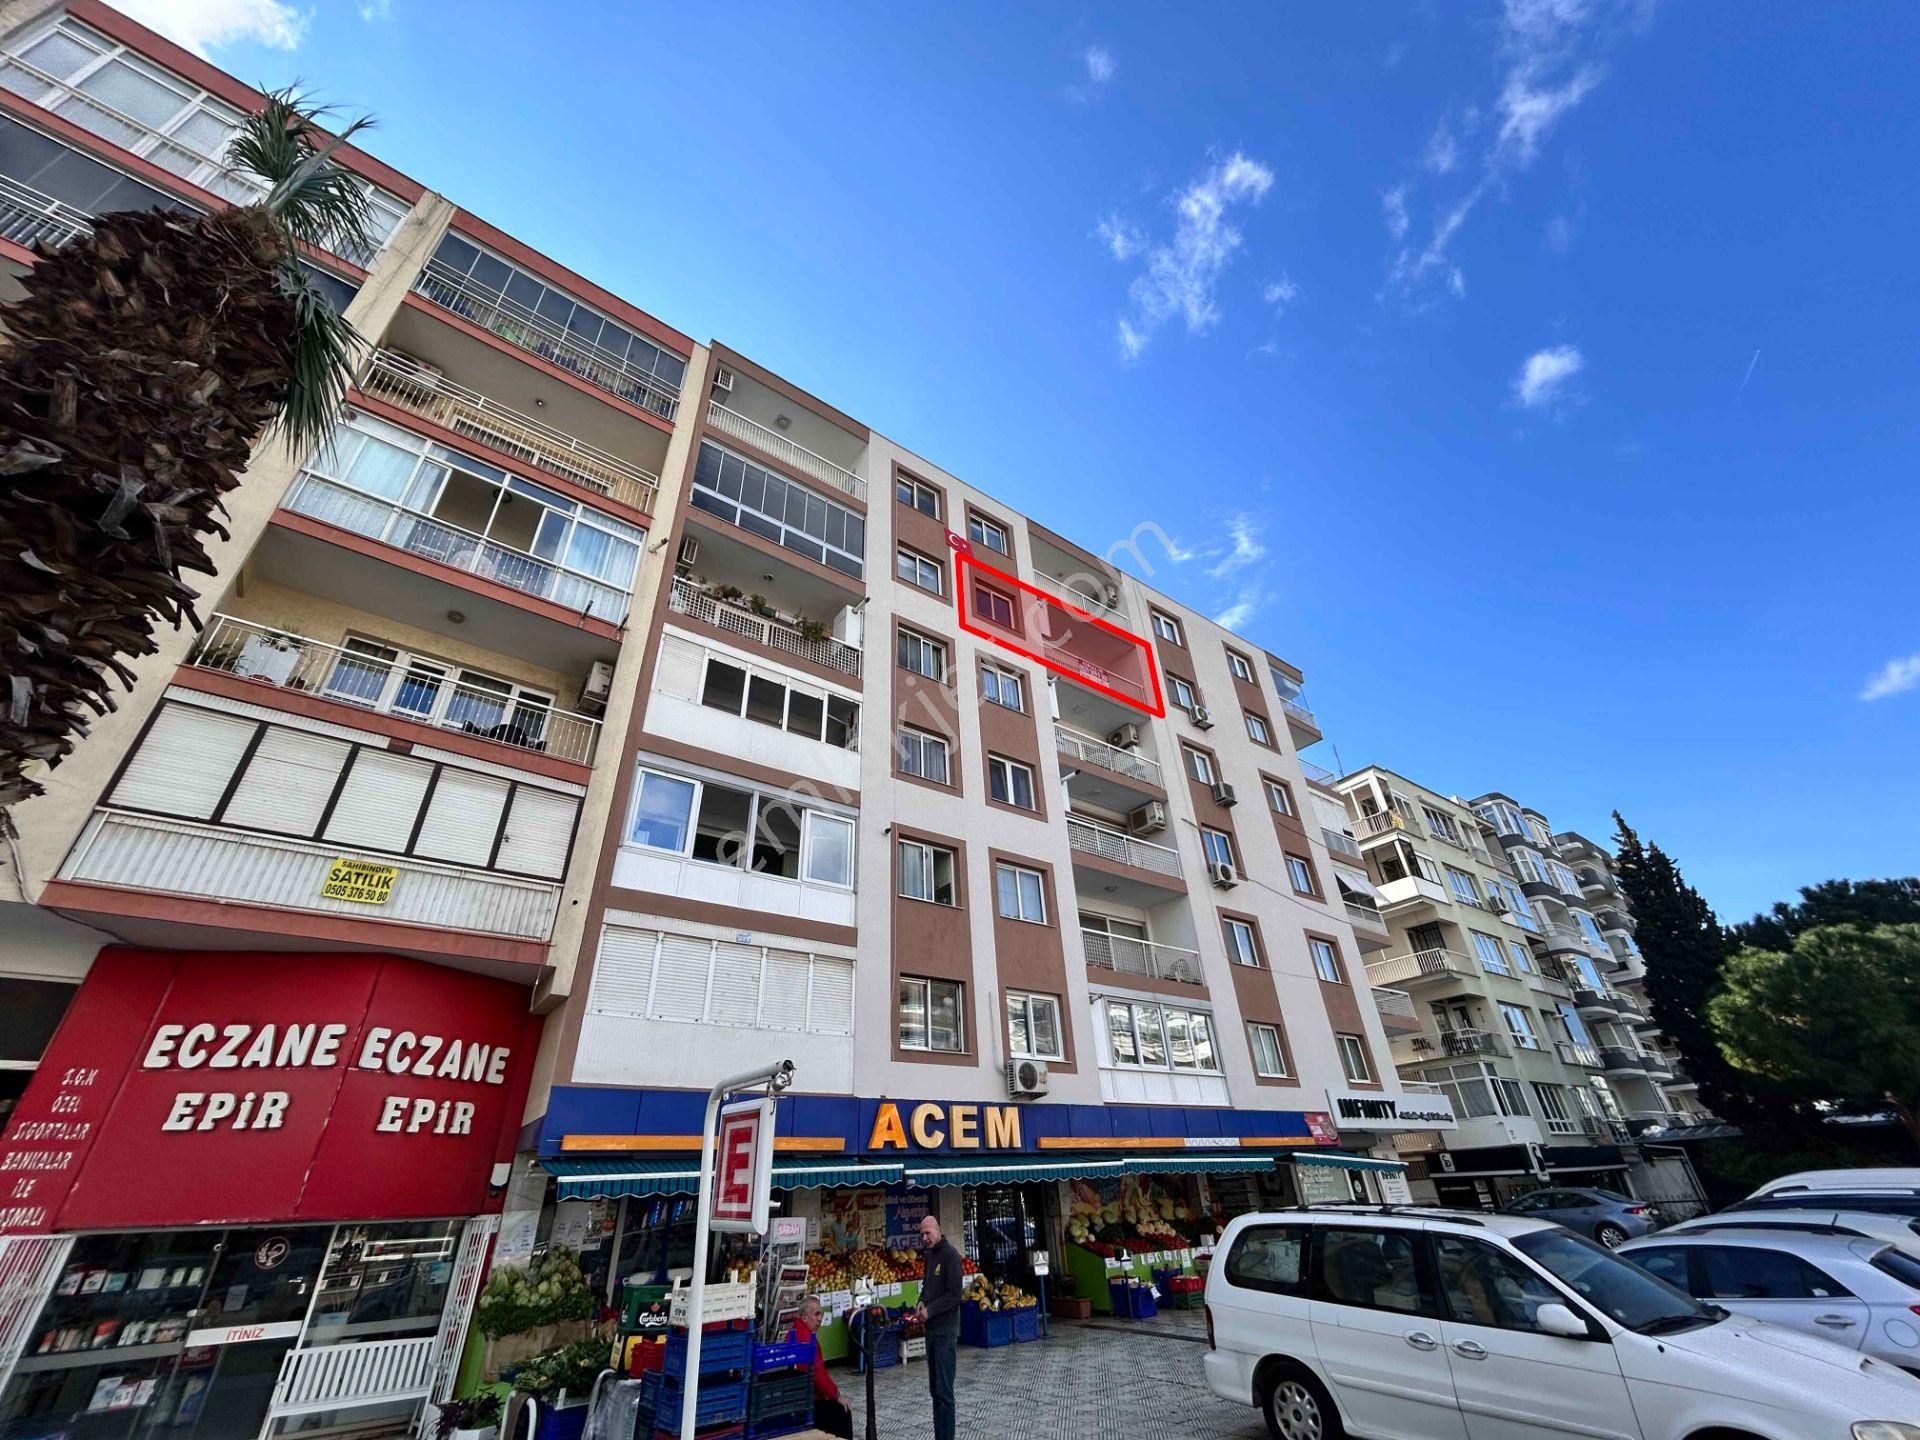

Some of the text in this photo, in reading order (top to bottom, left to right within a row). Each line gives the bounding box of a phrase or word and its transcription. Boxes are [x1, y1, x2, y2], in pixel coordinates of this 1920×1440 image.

[330, 869, 393, 889] SATILIK
[325, 884, 389, 902] 0505 376 50 80
[143, 1023, 347, 1069] ECZANE
[358, 1027, 511, 1084] ECZANE
[1337, 1098, 1397, 1119] INFINITY
[868, 1102, 1022, 1149] ACEM
[0, 1152, 73, 1171] BANKALAR
[722, 1126, 753, 1204] E
[639, 1311, 668, 1326] Carlsberg
